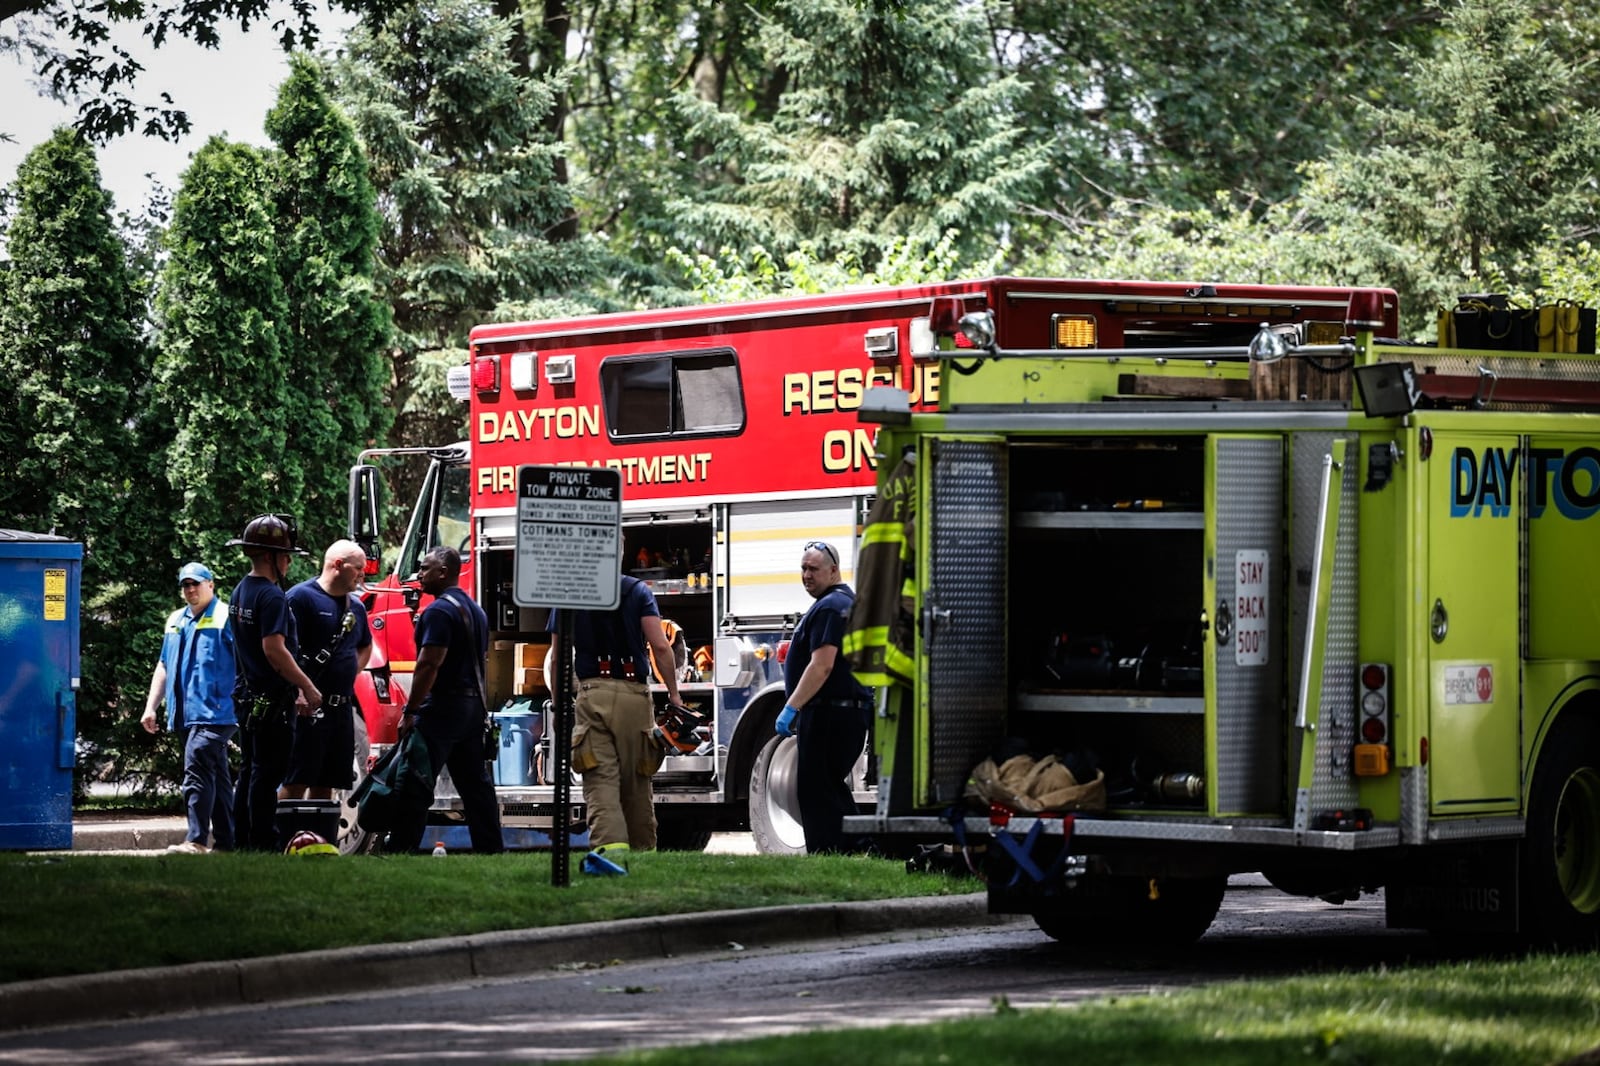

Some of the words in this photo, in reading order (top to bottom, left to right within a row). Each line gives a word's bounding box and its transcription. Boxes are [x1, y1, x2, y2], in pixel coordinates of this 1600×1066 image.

[783, 364, 940, 416] RESCUE
[479, 405, 600, 443] DAYTON
[478, 466, 520, 495] FIR
[537, 453, 713, 487] TMENT
[549, 471, 591, 485] PRIVATE
[1450, 446, 1600, 520] DAYTO
[526, 484, 548, 496] TOW
[553, 486, 581, 498] AWAY
[586, 487, 613, 499] ZONE
[526, 502, 577, 511] UNAUTHORIZED
[580, 505, 612, 513] VEHICLES
[557, 512, 584, 520] OWNERS
[586, 513, 616, 521] EXPENSE
[522, 525, 573, 537] COTTMANS
[578, 527, 615, 538] TOWING
[1240, 562, 1264, 585] STAY
[1238, 596, 1265, 619] BACK
[1477, 677, 1492, 692] 911
